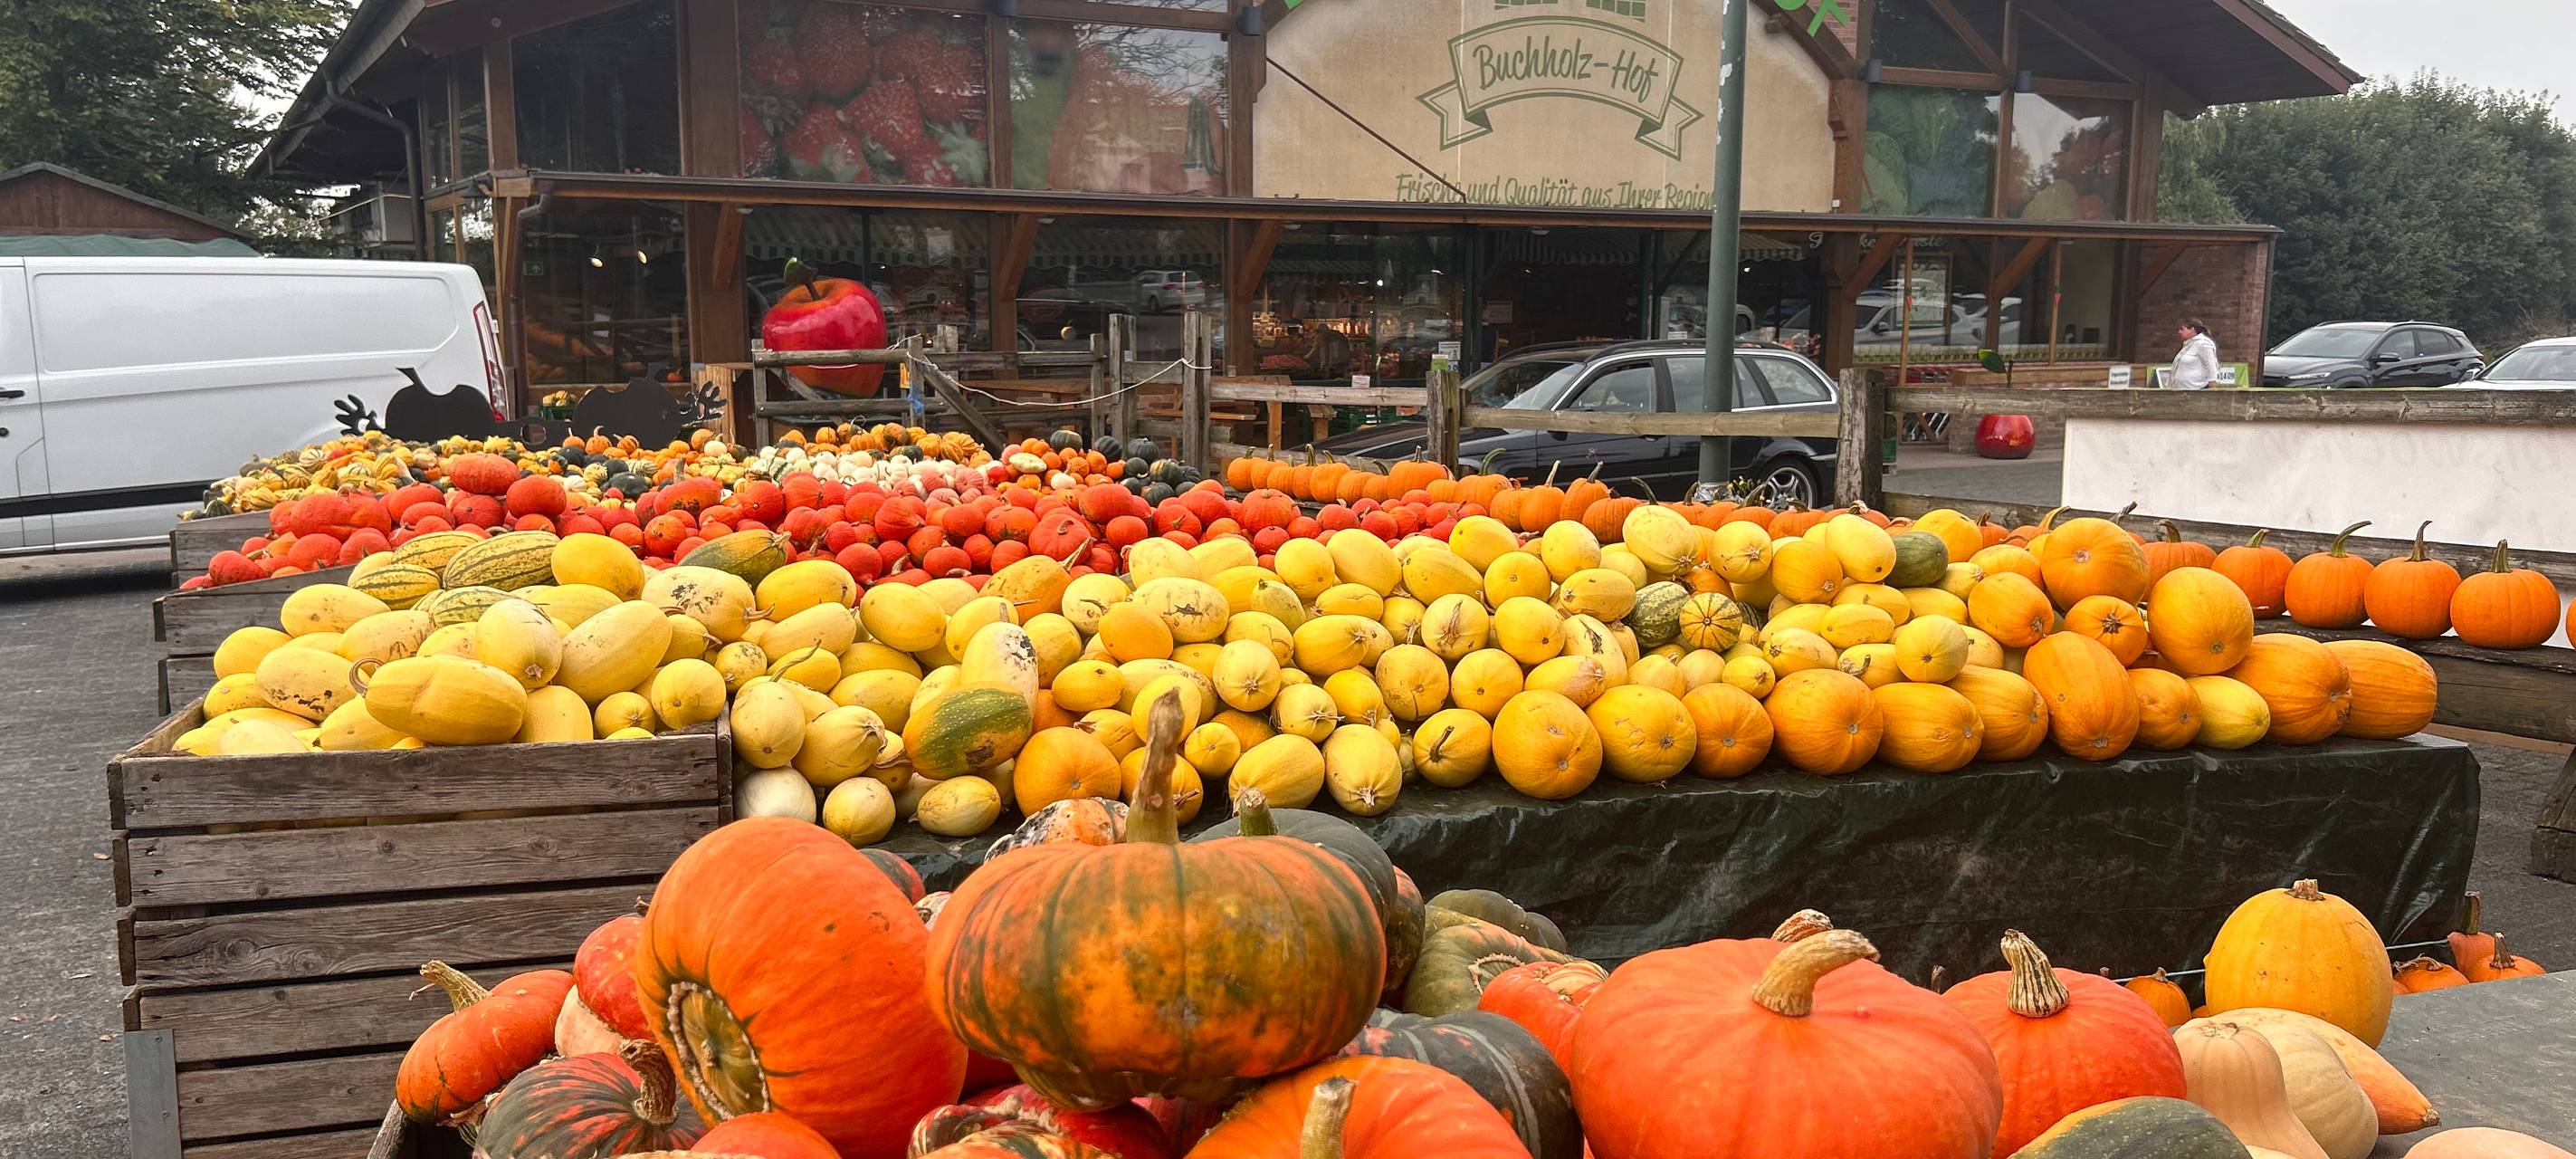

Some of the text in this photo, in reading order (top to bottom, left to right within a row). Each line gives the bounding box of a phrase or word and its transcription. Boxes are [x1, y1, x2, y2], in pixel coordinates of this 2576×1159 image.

[1473, 35, 1659, 103] Buchholz-Hof
[1467, 176, 1502, 205] und
[1504, 177, 1579, 206] Qualität
[1581, 187, 1613, 207] aus
[1614, 180, 1663, 209] Ihrer
